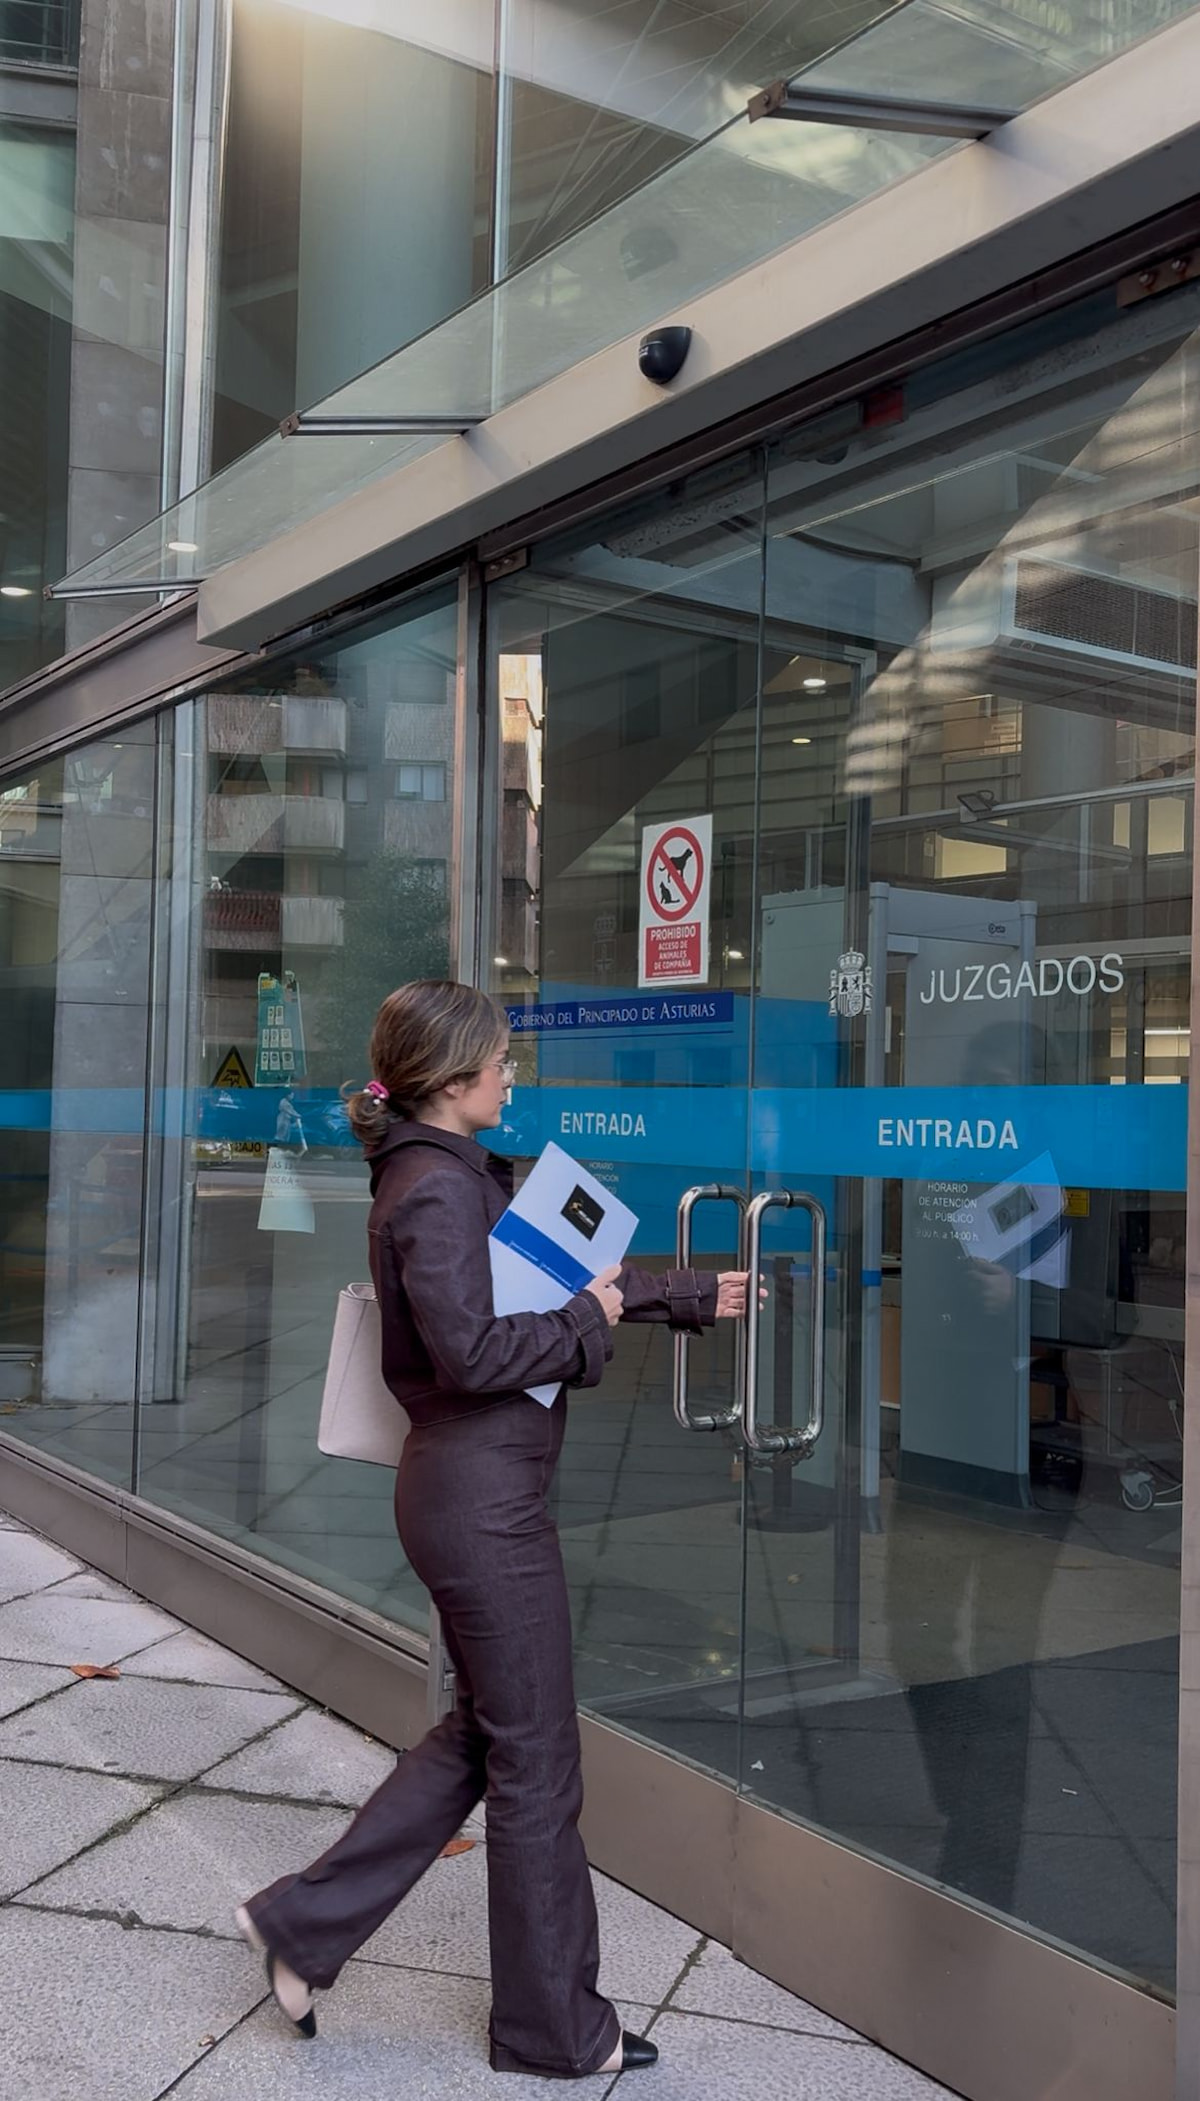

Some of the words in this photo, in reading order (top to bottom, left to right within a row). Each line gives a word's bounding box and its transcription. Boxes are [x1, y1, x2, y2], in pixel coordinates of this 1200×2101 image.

[650, 925, 696, 941] PROHIBIDO
[658, 941, 679, 951] ACCESO
[680, 940, 688, 949] DE
[659, 950, 688, 960] ANIMALES
[653, 961, 661, 970] DE
[920, 953, 1124, 1004] JUZGADOS
[508, 1011, 555, 1028] GOBIERNO
[557, 1011, 573, 1025] DEL
[578, 1007, 638, 1024] PRINCIPADO
[642, 1007, 655, 1020] DE
[660, 1002, 716, 1019] ASTURIAS
[560, 1112, 646, 1137] ENTRADA
[878, 1119, 1018, 1149] ENTRADA
[927, 1182, 968, 1193] HORARIO
[919, 1196, 931, 1206] DE
[923, 1211, 933, 1221] AL
[951, 1231, 971, 1241] 14:00
